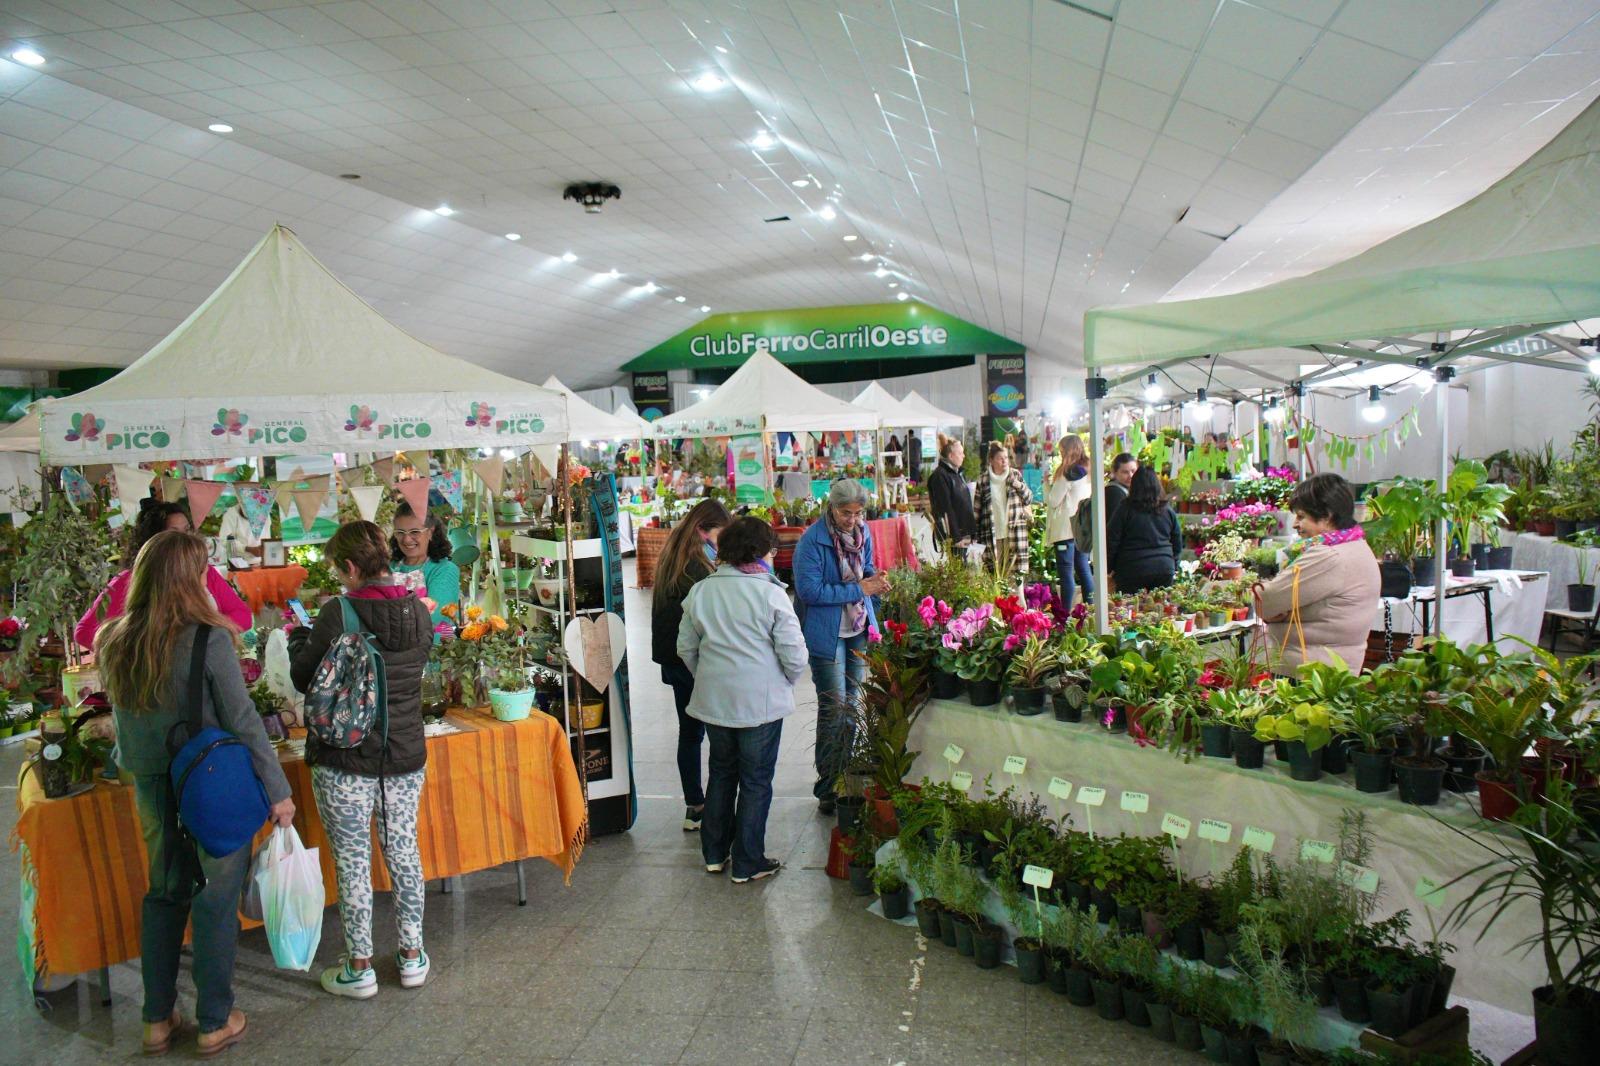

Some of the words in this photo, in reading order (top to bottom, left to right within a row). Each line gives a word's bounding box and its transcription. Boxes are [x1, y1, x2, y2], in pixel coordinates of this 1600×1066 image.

[248, 426, 307, 444] PICO
[378, 422, 432, 440] PICO
[495, 418, 545, 434] PICO
[106, 431, 171, 450] PICO
